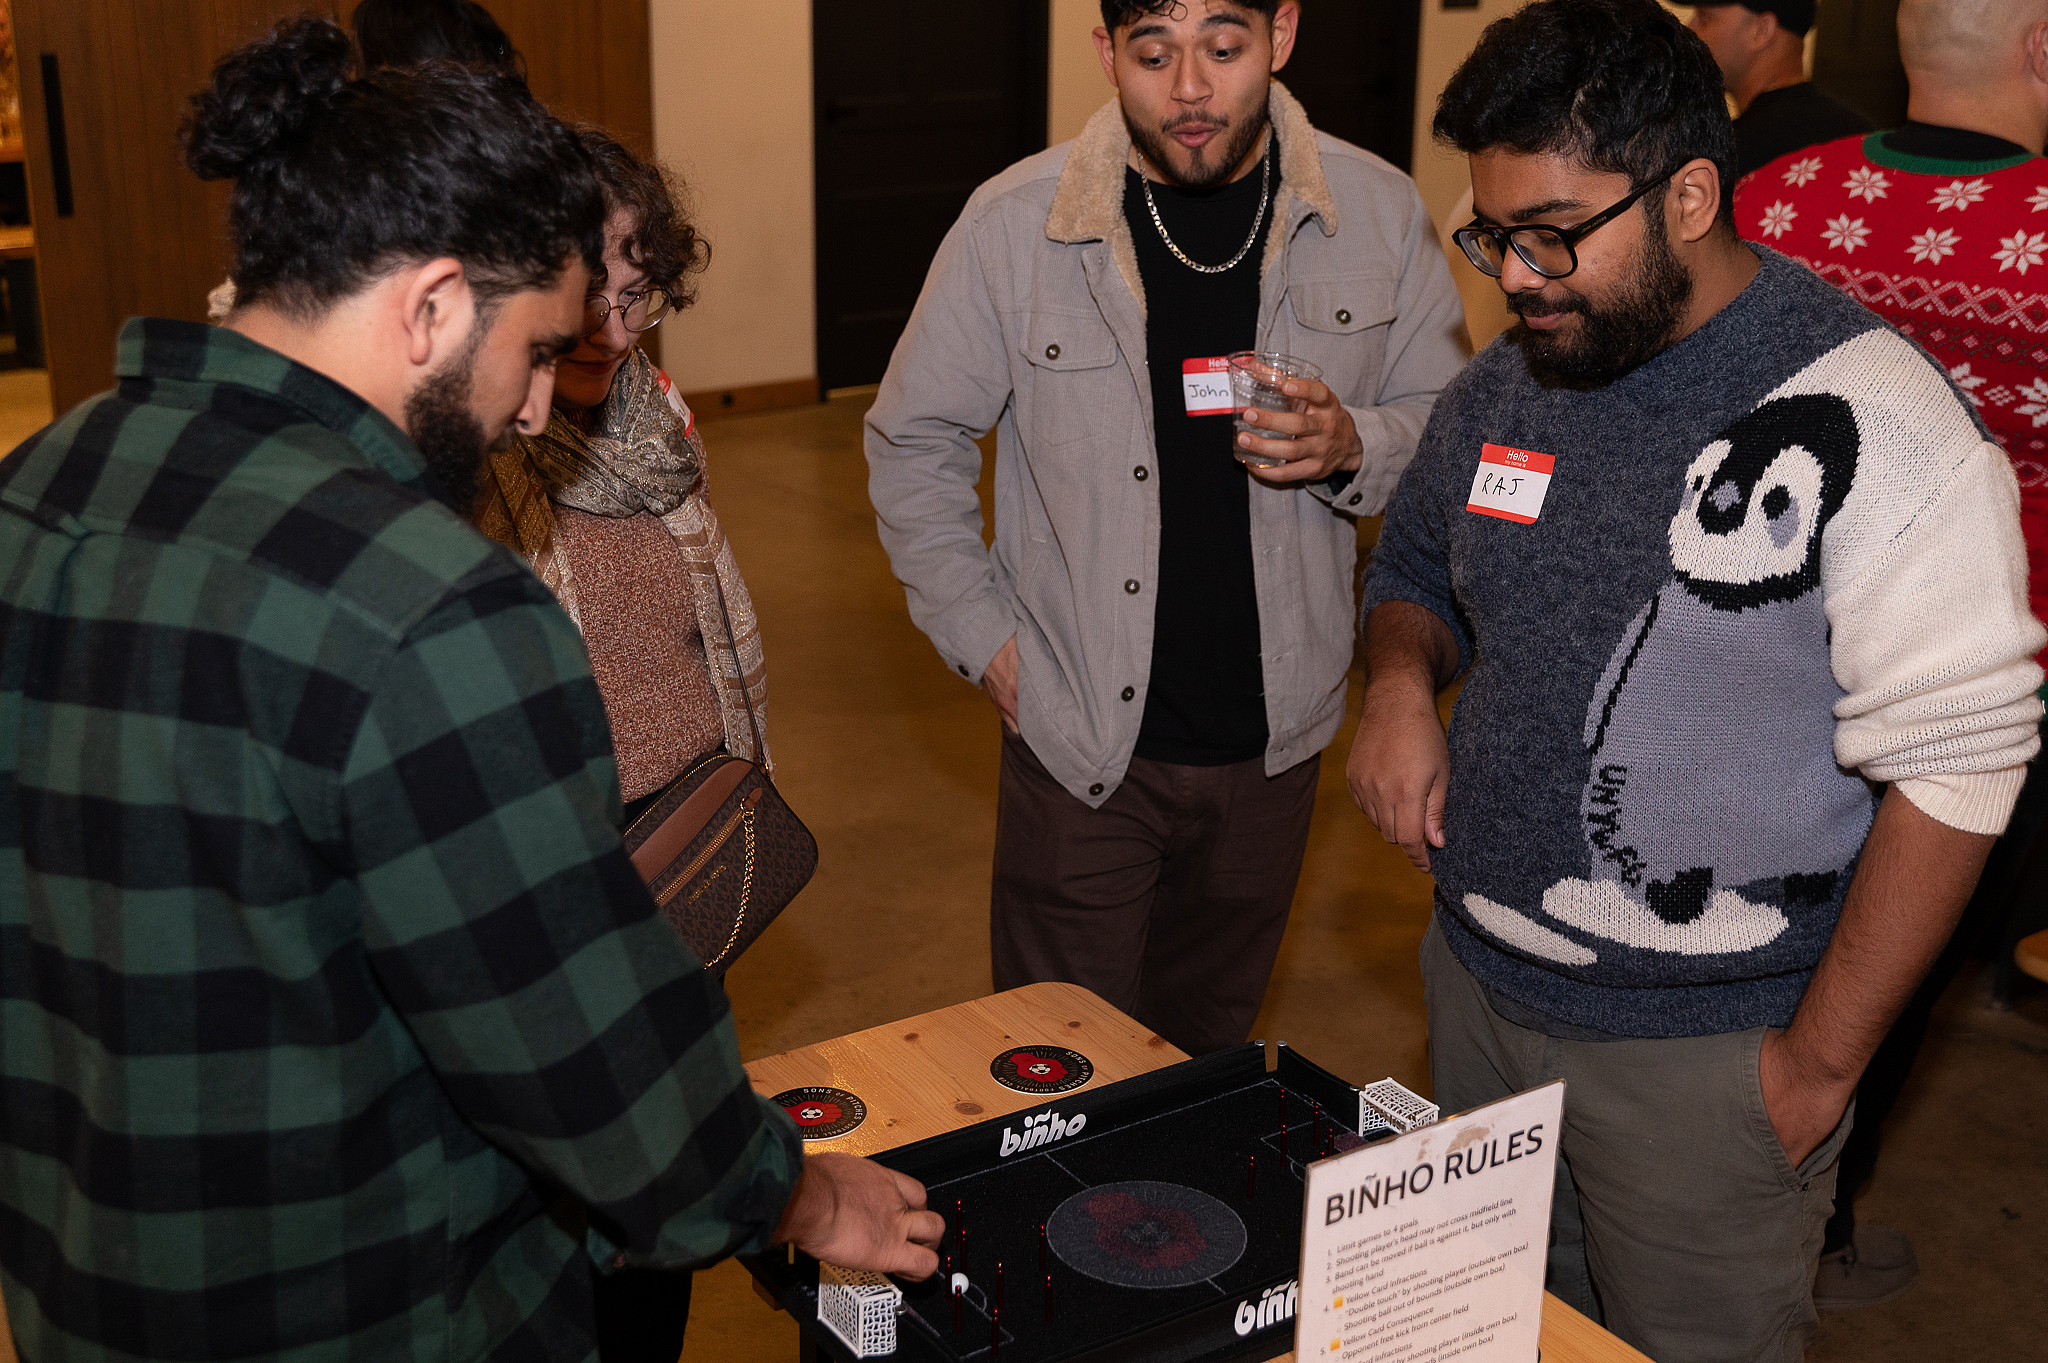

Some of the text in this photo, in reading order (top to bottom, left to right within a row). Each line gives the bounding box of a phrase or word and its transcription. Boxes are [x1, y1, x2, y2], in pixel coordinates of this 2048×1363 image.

[1188, 384, 1229, 398] John
[1506, 450, 1528, 462] Hello
[1482, 472, 1524, 496] RAJ
[1065, 1050, 1087, 1064] SONS
[1058, 1071, 1090, 1091] PITCHES
[846, 1096, 863, 1120] PITCHES
[823, 1121, 856, 1136] FOOTBALL
[1324, 1124, 1544, 1226] BIÑHO RULES
[1334, 1267, 1354, 1280] Band
[1356, 1262, 1368, 1272] can
[1370, 1259, 1379, 1267] be
[1382, 1248, 1406, 1262] moved
[1408, 1244, 1413, 1253] if
[1414, 1239, 1428, 1250] ball
[1437, 1227, 1461, 1243] against
[1471, 1220, 1483, 1230] but
[1485, 1214, 1500, 1225] only
[1502, 1208, 1516, 1219] with
[1336, 1250, 1369, 1267] Shooting
[1400, 1230, 1418, 1242] head
[1419, 1226, 1435, 1236] may
[1437, 1221, 1448, 1229] not
[1450, 1215, 1468, 1225] cross
[1470, 1201, 1499, 1218] midfield
[1500, 1198, 1513, 1206] line
[1337, 1242, 1356, 1253] Limit
[1358, 1234, 1381, 1247] games
[1399, 1218, 1418, 1232] goals
[1332, 1268, 1384, 1294] shooting hand
[1402, 1287, 1411, 1296] by
[1412, 1275, 1443, 1292] shooting
[1445, 1266, 1466, 1281] player
[1468, 1255, 1496, 1272] (outside
[1497, 1249, 1512, 1259] own
[1514, 1241, 1529, 1254] box)
[1234, 1279, 1298, 1336] biñh
[1344, 1262, 1505, 1330] Shooting ball out of bounds (outside own box)
[1346, 1290, 1370, 1304] Yellow
[1371, 1282, 1388, 1294] Card
[1341, 1303, 1469, 1360] Opponent free kick from center field
[1342, 1332, 1367, 1346] Yellow
[1368, 1325, 1384, 1336] Card
[1386, 1306, 1434, 1329] Consequence
[1407, 1345, 1437, 1361] shooting
[1439, 1336, 1460, 1350] player
[1462, 1326, 1484, 1341] (inside
[1486, 1320, 1500, 1330] own
[1502, 1312, 1517, 1324] box)
[1438, 1348, 1461, 1362] (inside
[1462, 1341, 1477, 1352] own
[1478, 1333, 1494, 1346] box)
